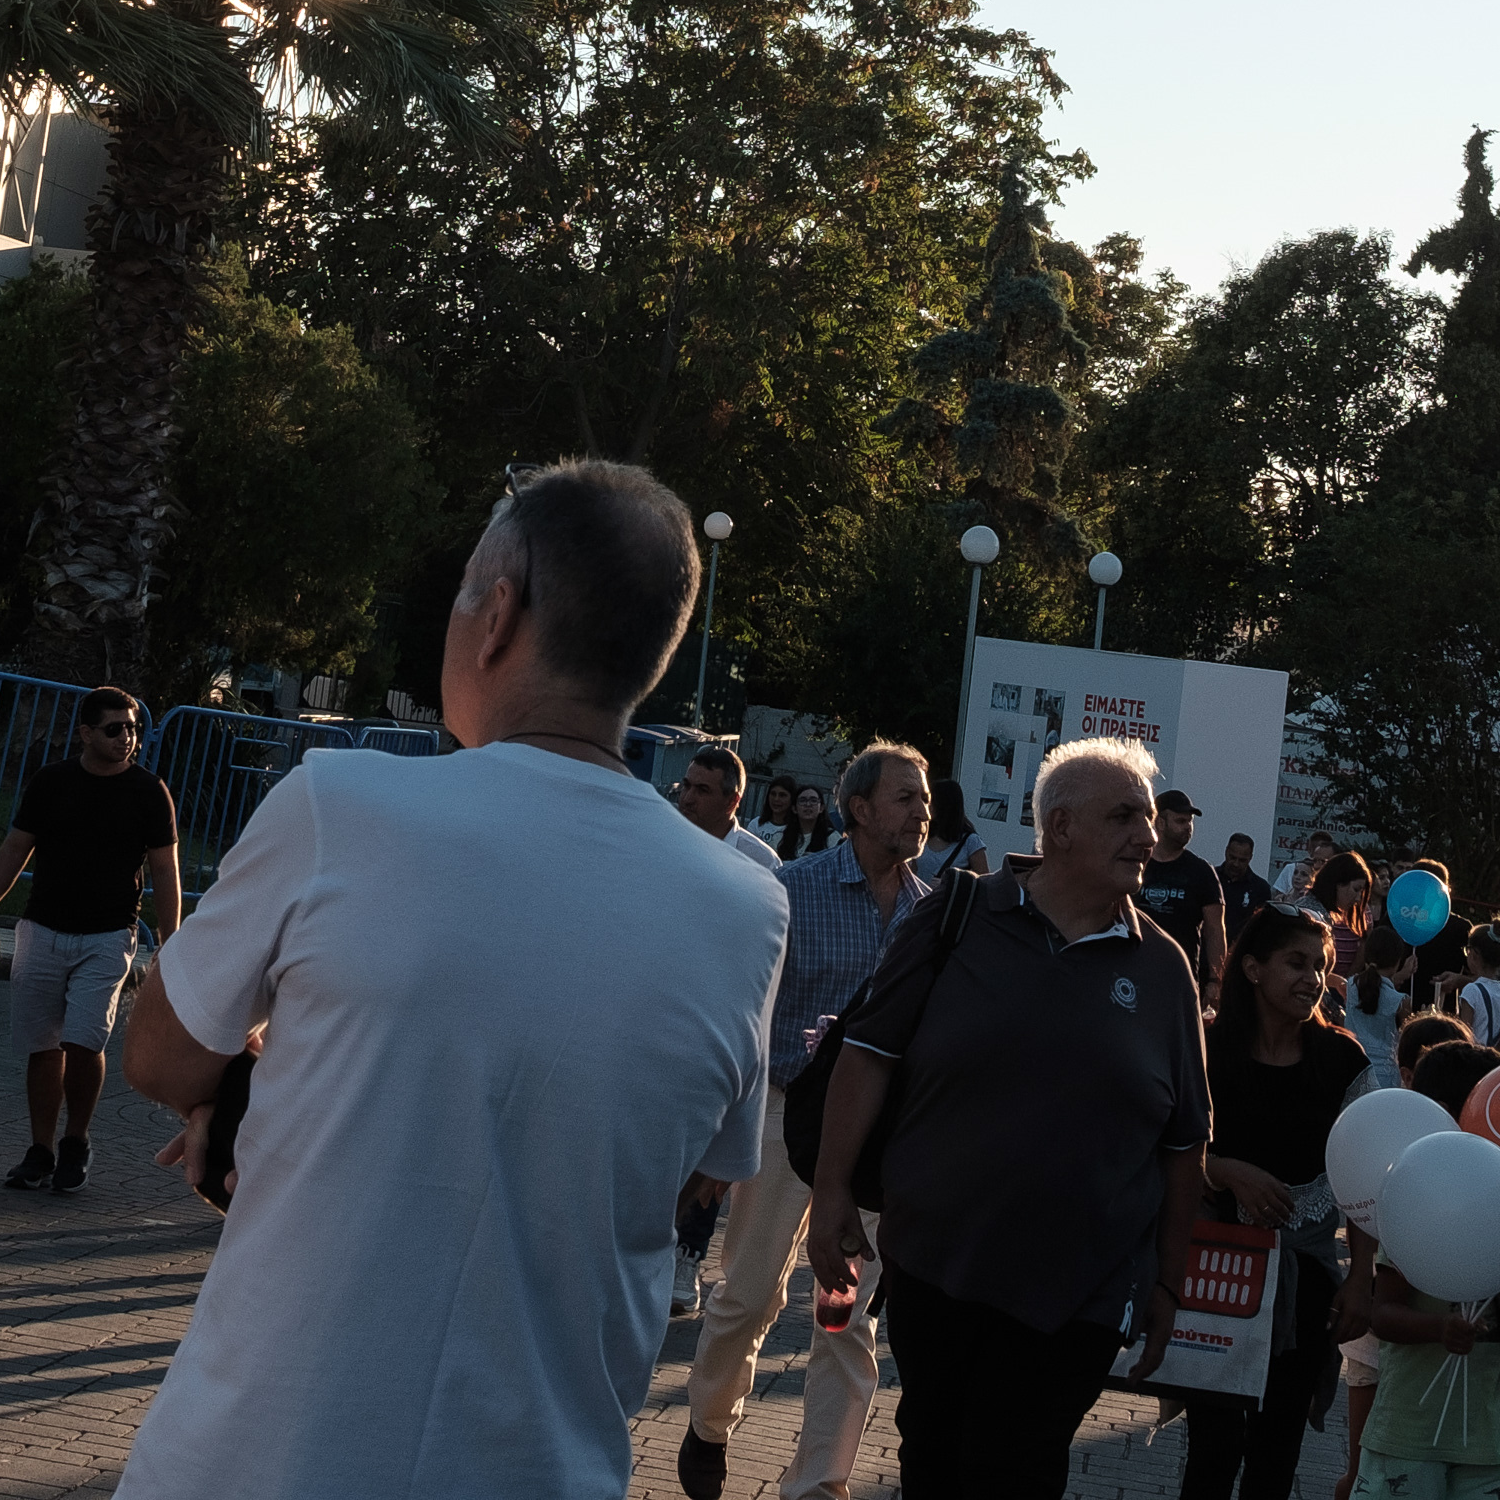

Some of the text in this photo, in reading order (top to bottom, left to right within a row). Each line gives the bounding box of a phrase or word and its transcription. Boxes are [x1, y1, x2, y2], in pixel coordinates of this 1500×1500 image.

[1084, 693, 1146, 719] ΕΙΜΑΣΤΕ
[1081, 715, 1161, 743] ΟΙ ΠΡΑΞΕΙΣ
[1172, 1328, 1233, 1347] ούτης
